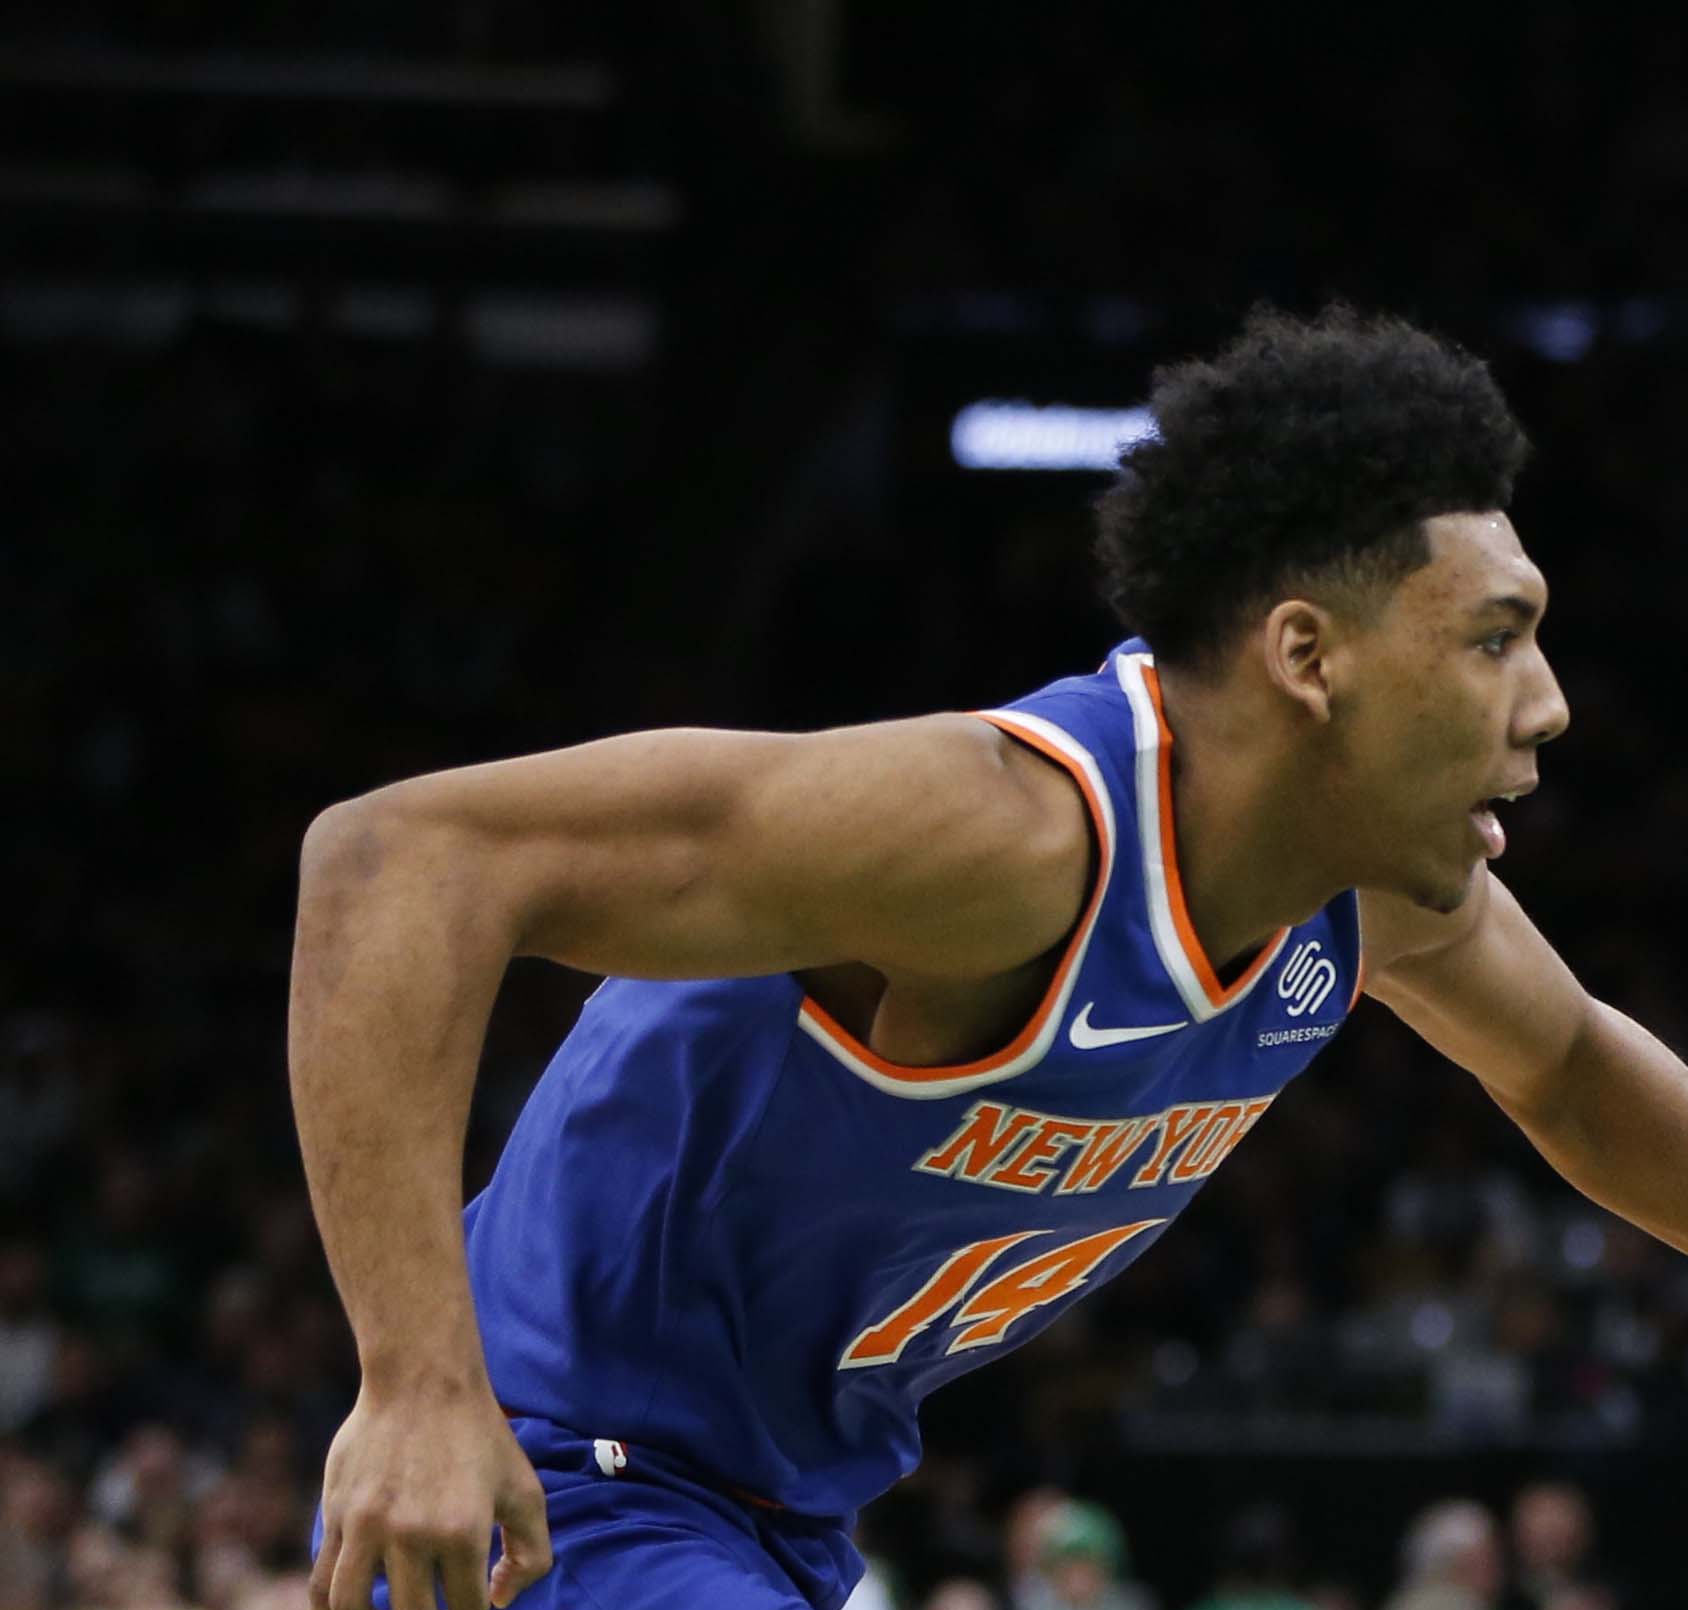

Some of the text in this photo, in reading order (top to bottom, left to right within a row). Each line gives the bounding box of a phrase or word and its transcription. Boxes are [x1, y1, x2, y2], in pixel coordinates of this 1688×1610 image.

[1257, 1023, 1340, 1048] SQUARESPAC
[912, 1092, 1278, 1197] NEW YOR
[837, 1218, 1169, 1370] 14
